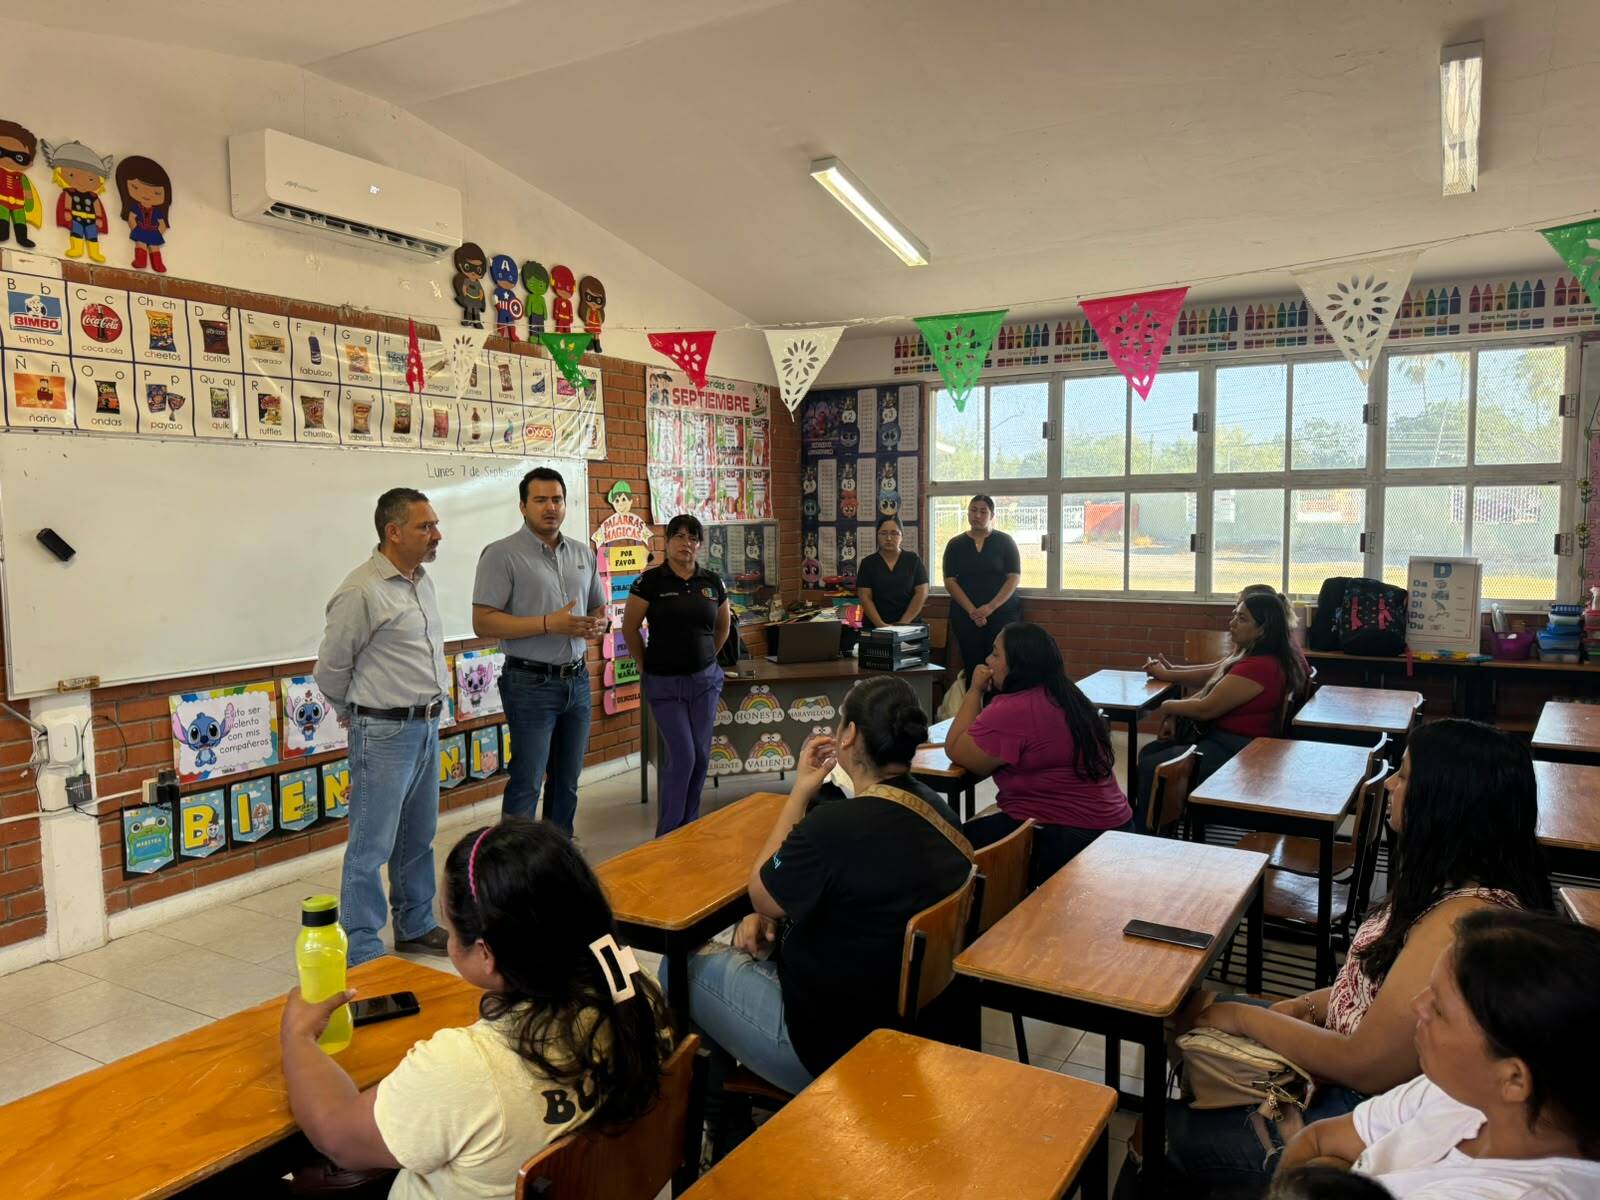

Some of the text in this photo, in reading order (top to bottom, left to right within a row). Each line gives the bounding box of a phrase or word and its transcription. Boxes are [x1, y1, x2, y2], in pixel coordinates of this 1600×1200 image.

[7, 278, 51, 295] B b
[75, 288, 114, 305] C c
[137, 295, 176, 310] Ch ch
[194, 305, 204, 317] D
[14, 315, 59, 330] BIMBO
[247, 313, 281, 329] E e
[19, 334, 55, 347] bimbo
[341, 329, 372, 345] G g
[384, 335, 391, 346] H
[81, 344, 124, 355] coca cola
[144, 351, 182, 362] cheetos
[202, 352, 231, 364] doritos
[15, 354, 61, 374] Ñ ñ
[81, 364, 94, 377] O
[300, 366, 333, 378] fabuloso
[143, 370, 180, 386] P p
[199, 374, 236, 388] Qu qu
[251, 380, 259, 392] R
[345, 390, 352, 400] S
[672, 386, 751, 413] SEPTIEMBRE
[28, 413, 57, 424] ñoño
[90, 417, 123, 427] ondas
[150, 421, 183, 432] payaso
[211, 421, 230, 432] quik
[525, 426, 554, 438] OXXO
[426, 462, 456, 479] Lunes
[460, 464, 466, 477] 7
[469, 465, 481, 478] de
[603, 514, 644, 531] PALABRAS
[603, 525, 642, 541] MAGICAS
[620, 550, 633, 558] POR
[615, 559, 636, 567] FAVOR
[248, 706, 261, 716] ser
[736, 711, 784, 720] HONESTA
[228, 717, 260, 729] violento
[227, 729, 261, 742] con mis
[219, 739, 270, 754] compañeros
[747, 758, 794, 769] VALIENTE
